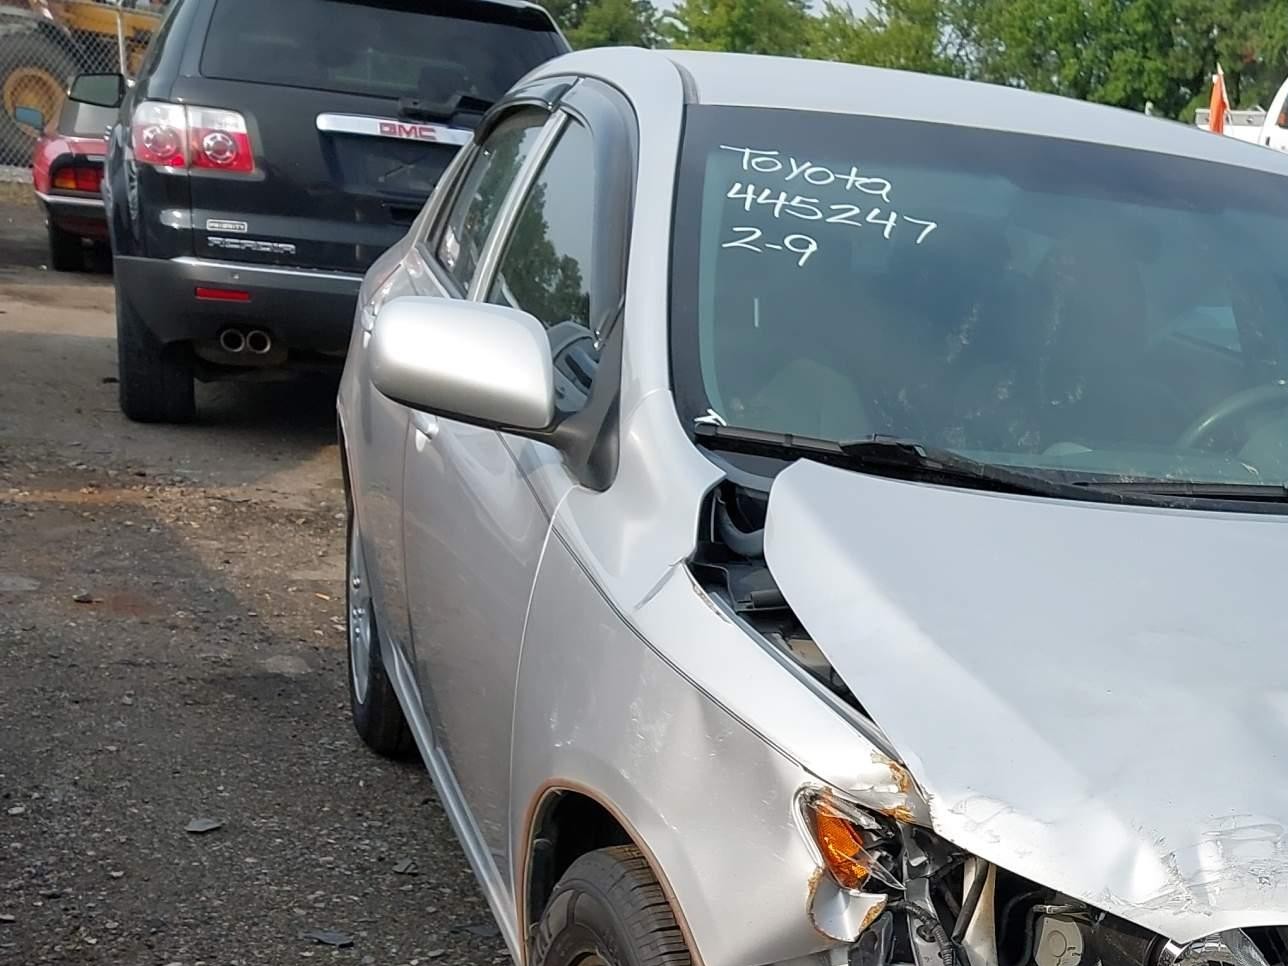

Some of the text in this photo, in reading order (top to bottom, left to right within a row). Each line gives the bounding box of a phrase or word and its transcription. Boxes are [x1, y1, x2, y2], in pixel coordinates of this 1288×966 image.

[380, 123, 437, 140] GMC
[720, 144, 893, 203] Toyota
[727, 183, 938, 244] 445247
[721, 226, 818, 267] 2-9
